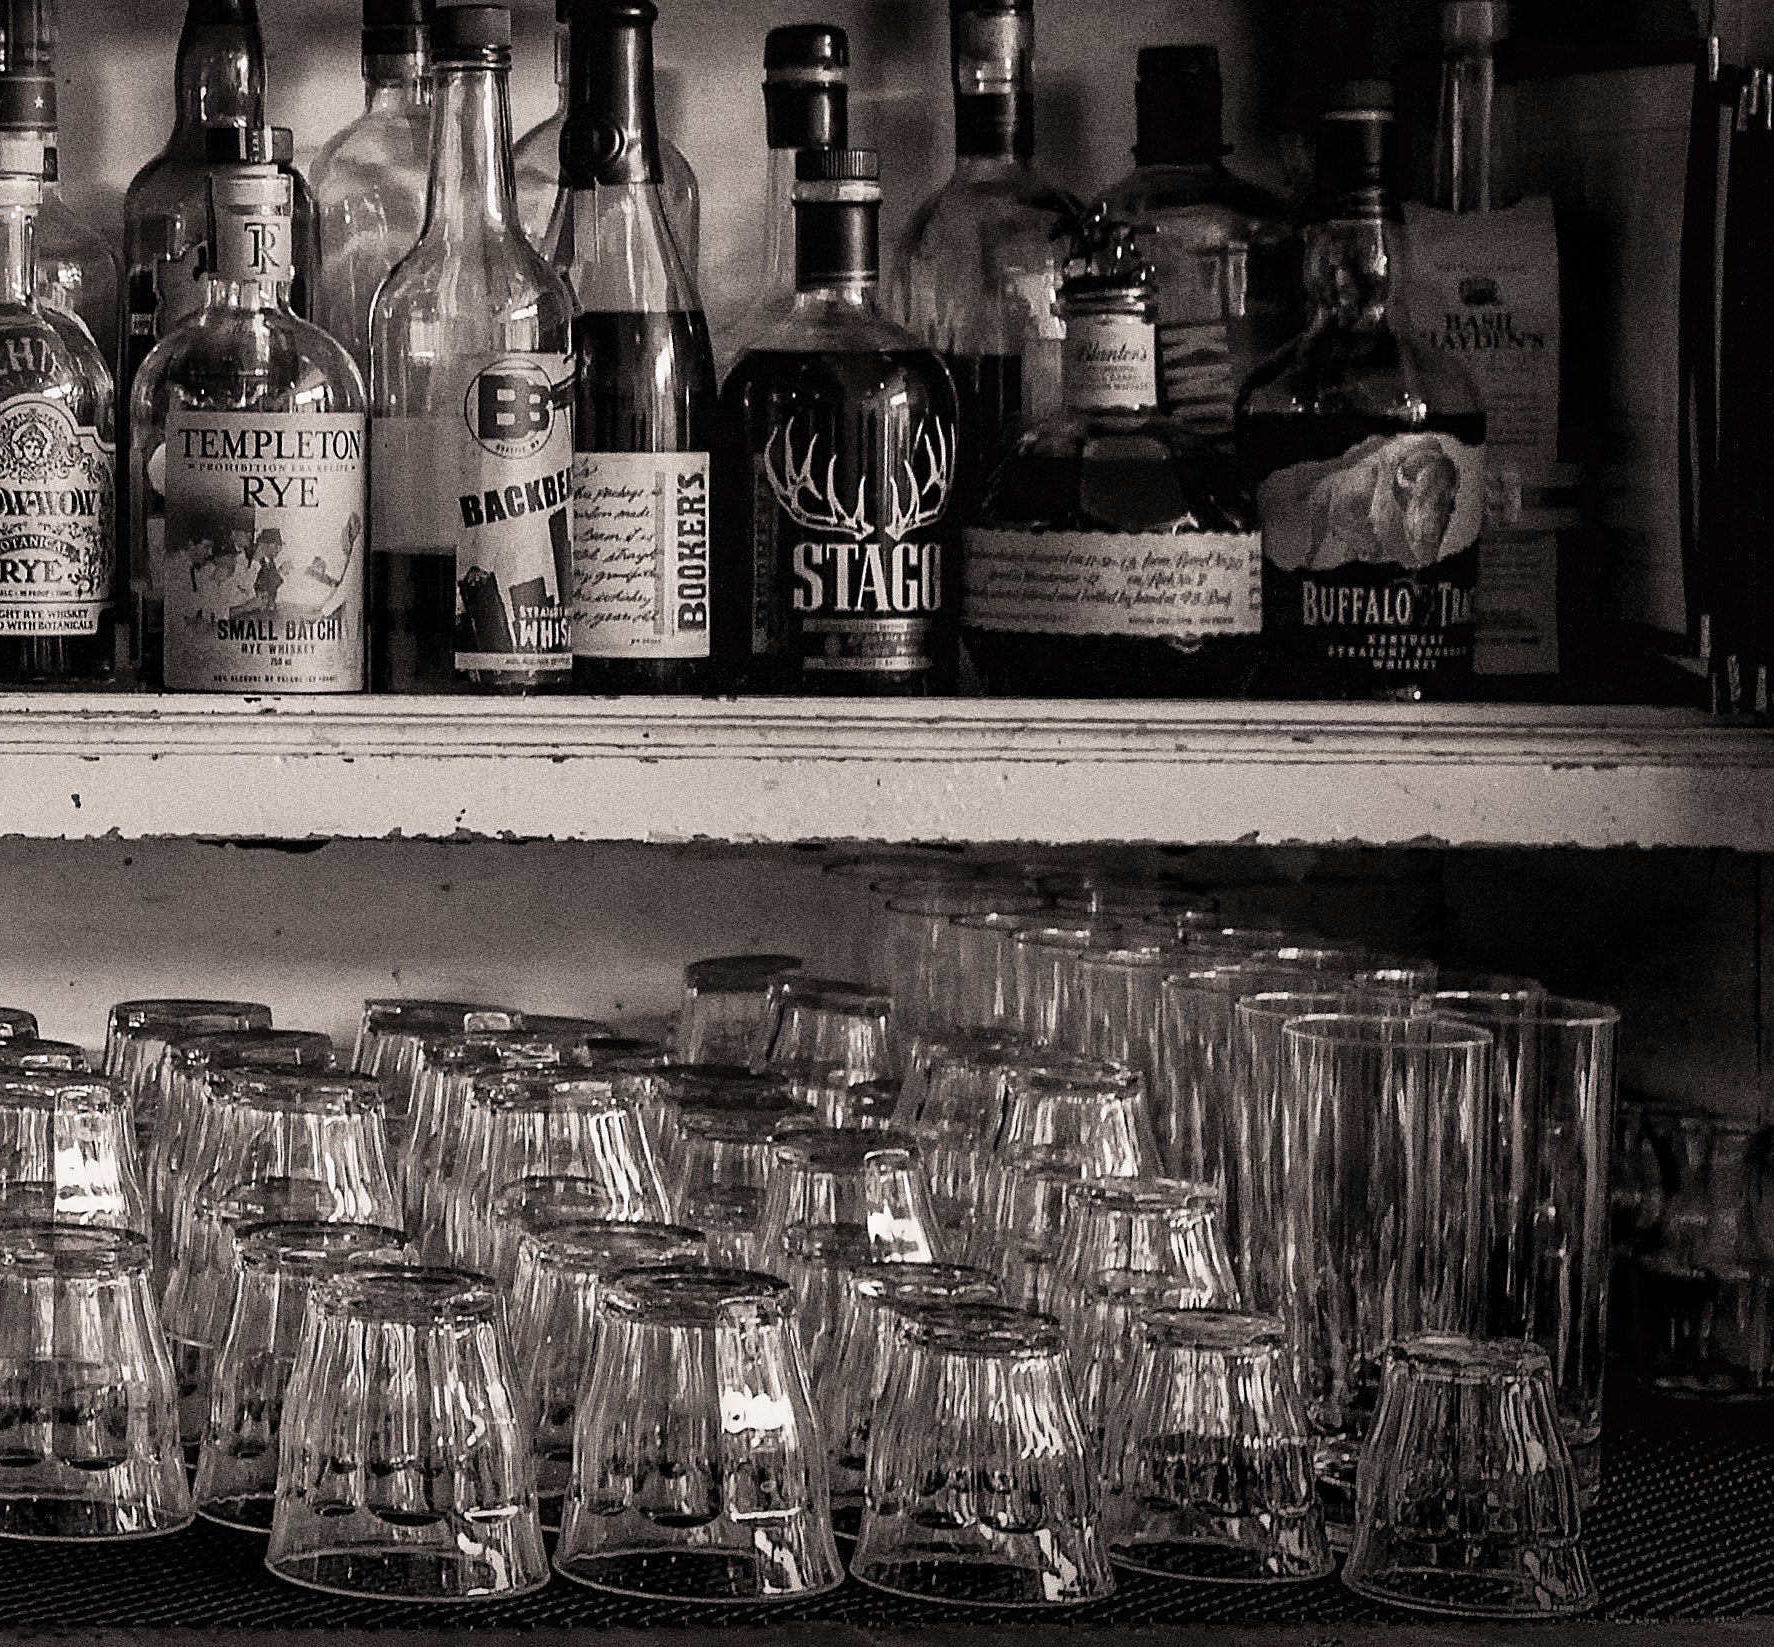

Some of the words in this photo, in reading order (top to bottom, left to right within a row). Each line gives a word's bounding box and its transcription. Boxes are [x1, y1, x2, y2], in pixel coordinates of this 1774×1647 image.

[179, 429, 361, 460] TEMPLETON
[200, 463, 287, 472] PROHIBITION
[241, 477, 319, 508] RYE
[678, 473, 706, 630] BOOKER'S
[0, 559, 62, 583] RYE
[23, 610, 43, 619] RYE
[48, 610, 88, 619] WHISKEY
[1302, 581, 1411, 626] BUFFALO
[7, 621, 36, 631] WITH
[38, 621, 93, 630] BOTANICALS
[218, 620, 278, 640] SMALL
[286, 620, 336, 640] BATCH
